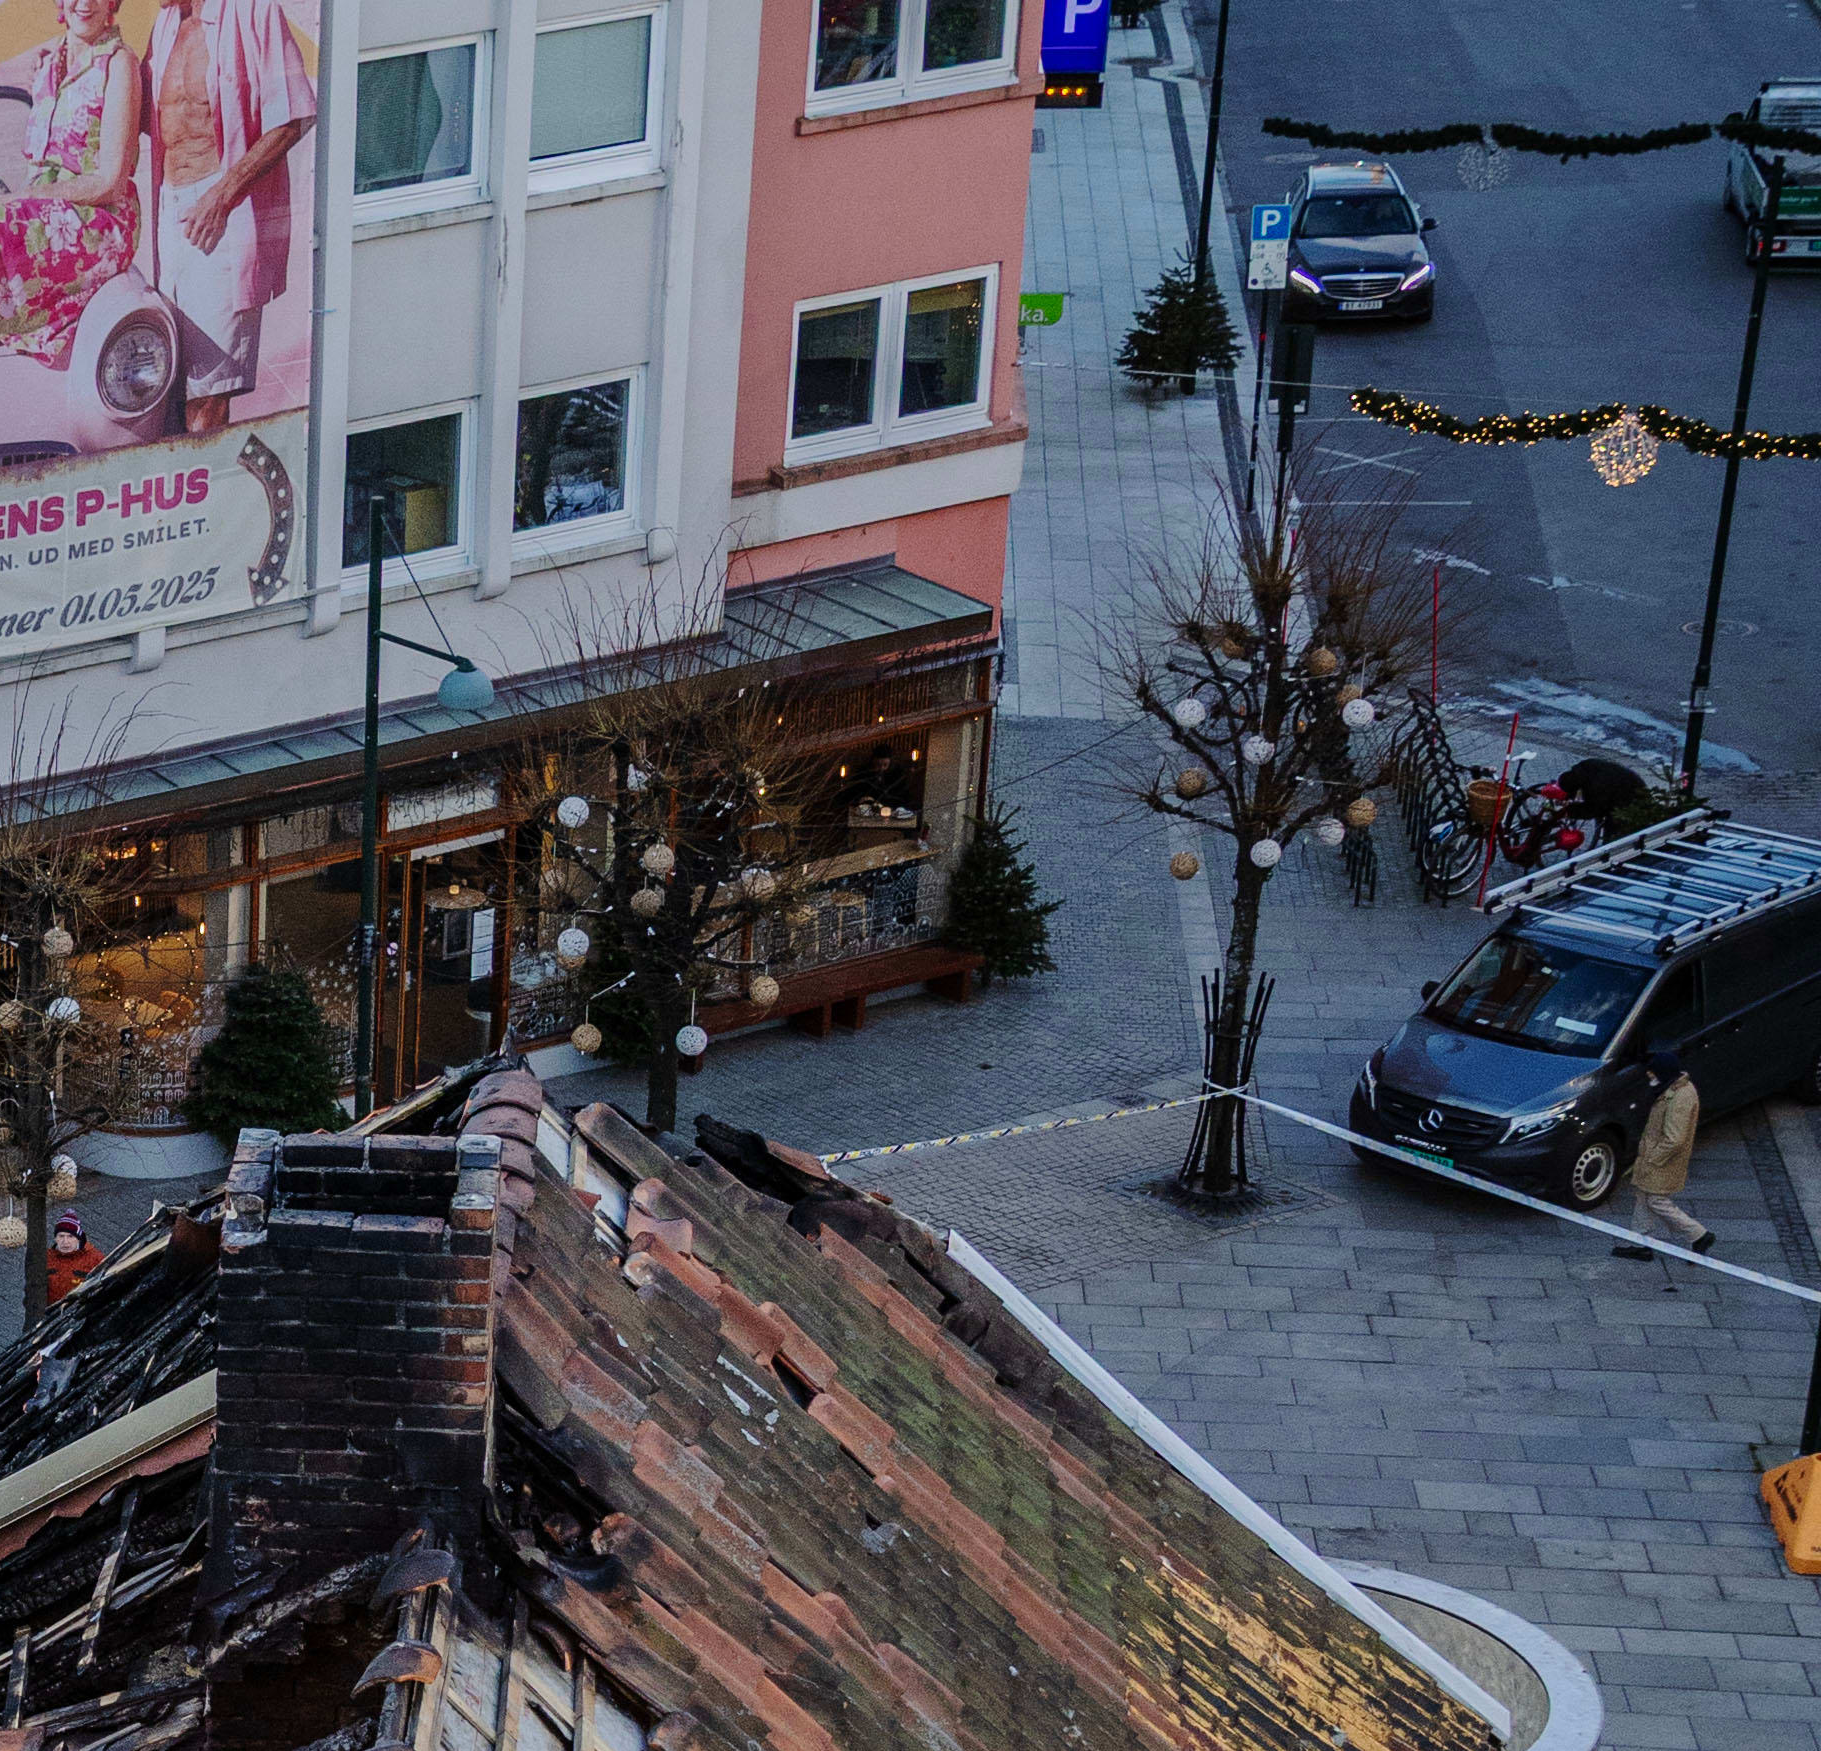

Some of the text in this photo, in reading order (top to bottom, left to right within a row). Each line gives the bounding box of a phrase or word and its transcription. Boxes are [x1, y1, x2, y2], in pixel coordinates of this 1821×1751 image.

[1261, 209, 1281, 236] P
[76, 467, 210, 528] P-HUS
[68, 538, 117, 562] MED
[123, 518, 211, 552] SMILET.
[58, 565, 222, 631] 01.05.2025
